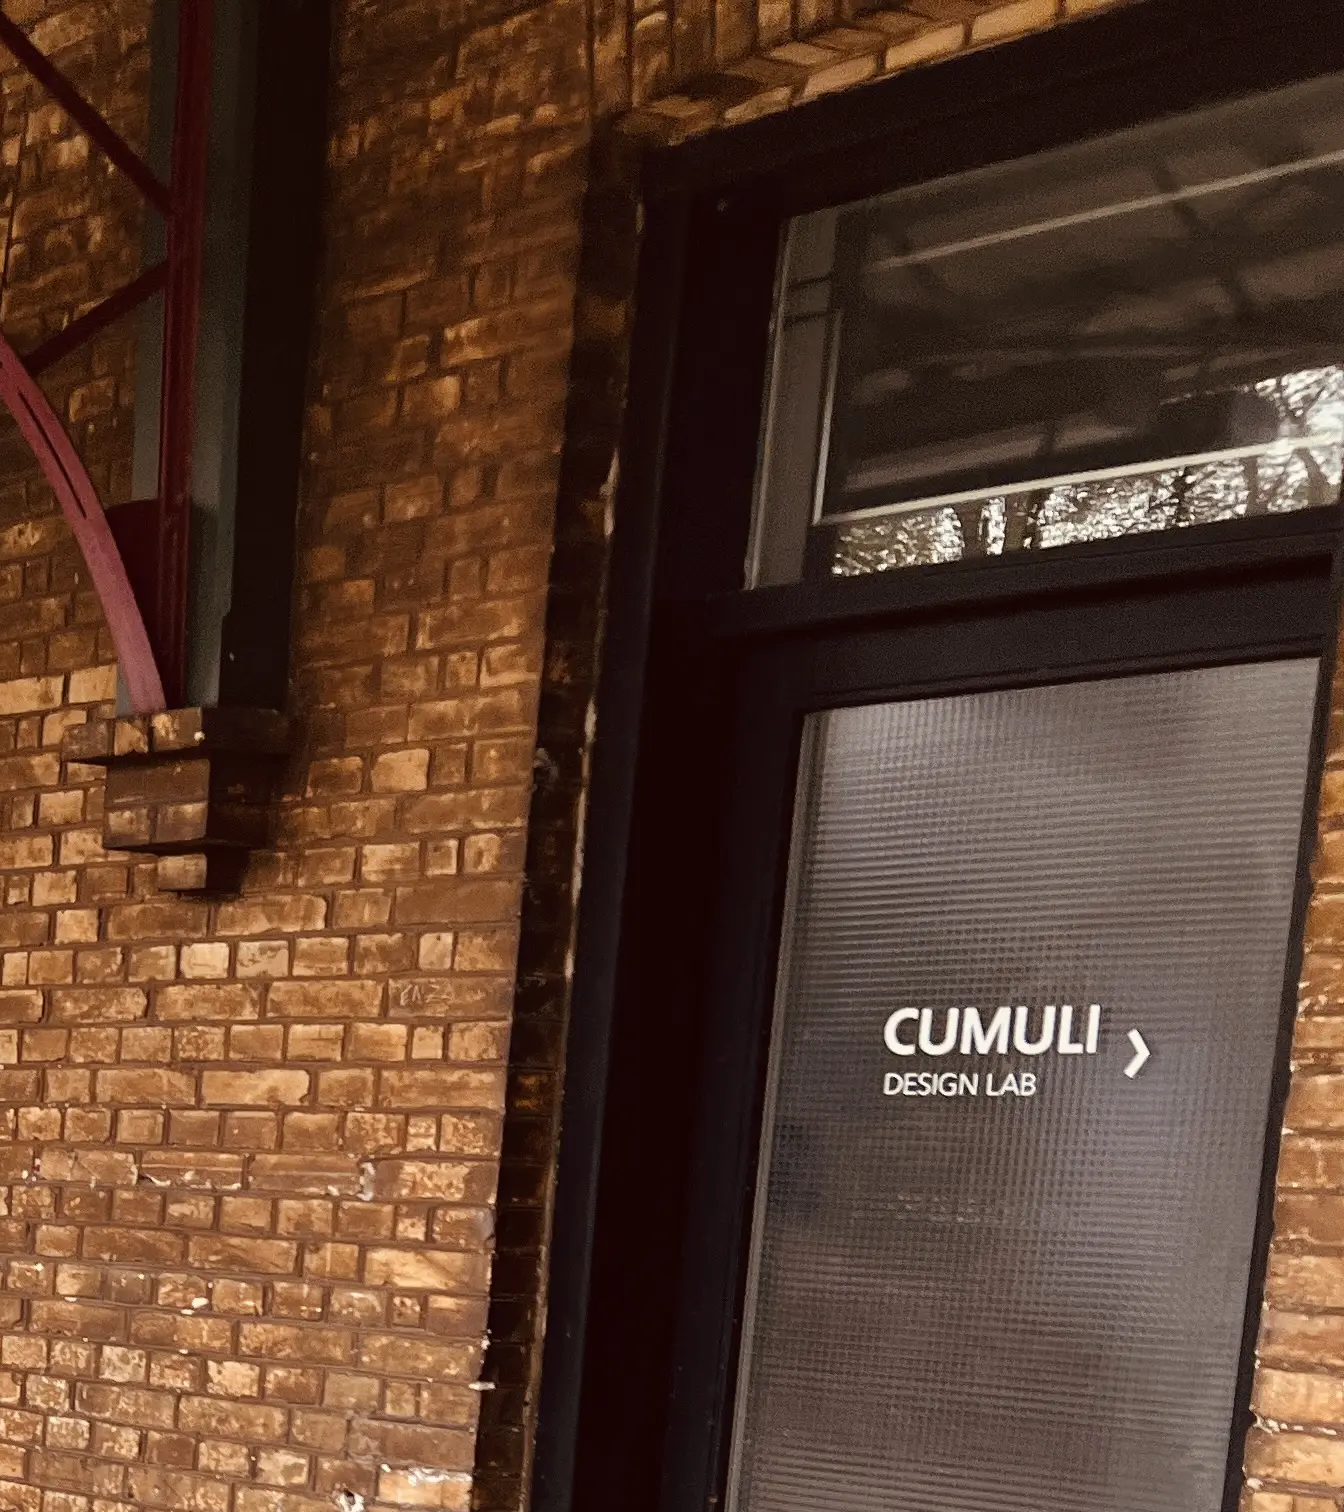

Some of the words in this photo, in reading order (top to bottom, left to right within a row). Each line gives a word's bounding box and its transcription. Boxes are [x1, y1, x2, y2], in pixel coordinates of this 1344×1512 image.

[883, 1004, 1100, 1056] CUMULI
[883, 1072, 977, 1096] DESIGN
[986, 1072, 1037, 1097] LAB
